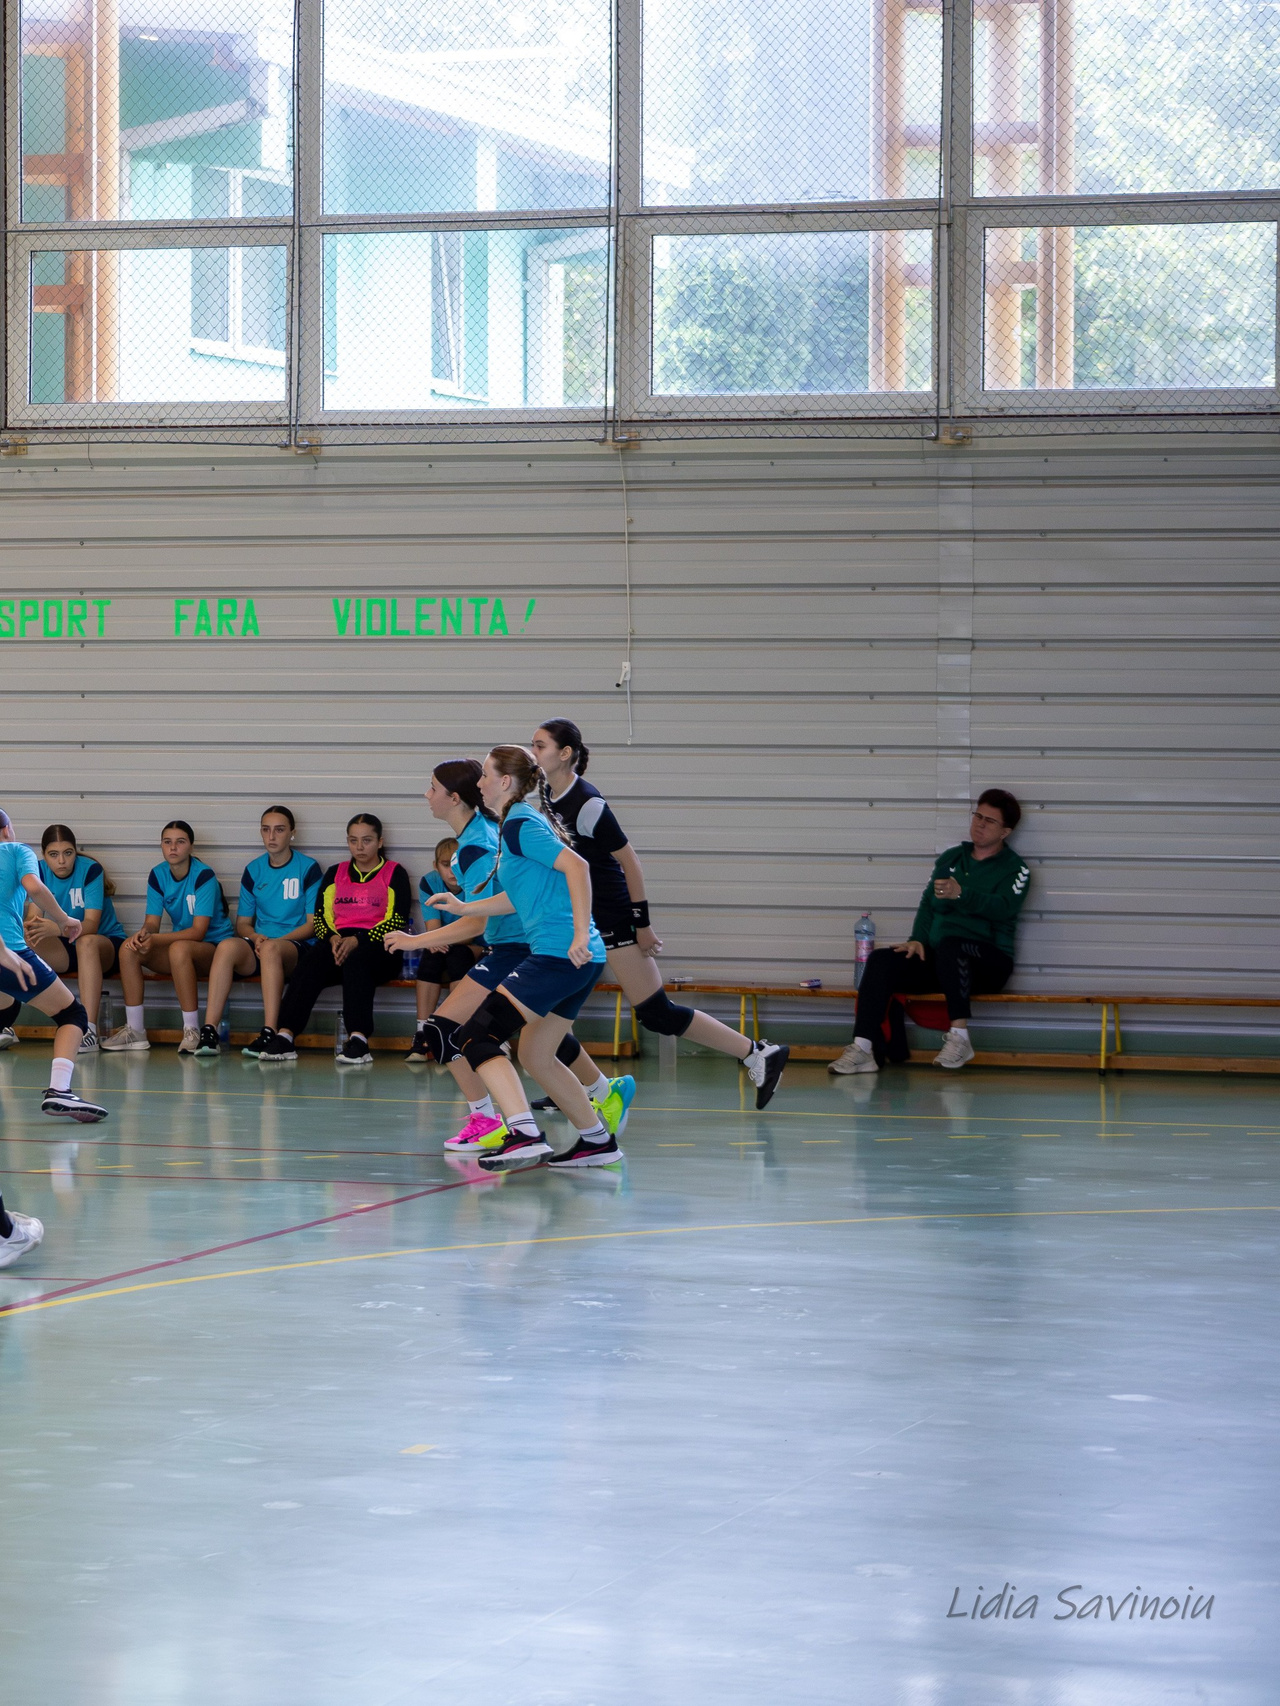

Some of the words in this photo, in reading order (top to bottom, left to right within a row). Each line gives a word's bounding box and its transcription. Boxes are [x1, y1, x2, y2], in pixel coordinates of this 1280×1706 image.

[174, 599, 260, 636] FARA
[69, 888, 85, 909] 14
[282, 878, 299, 899] 10
